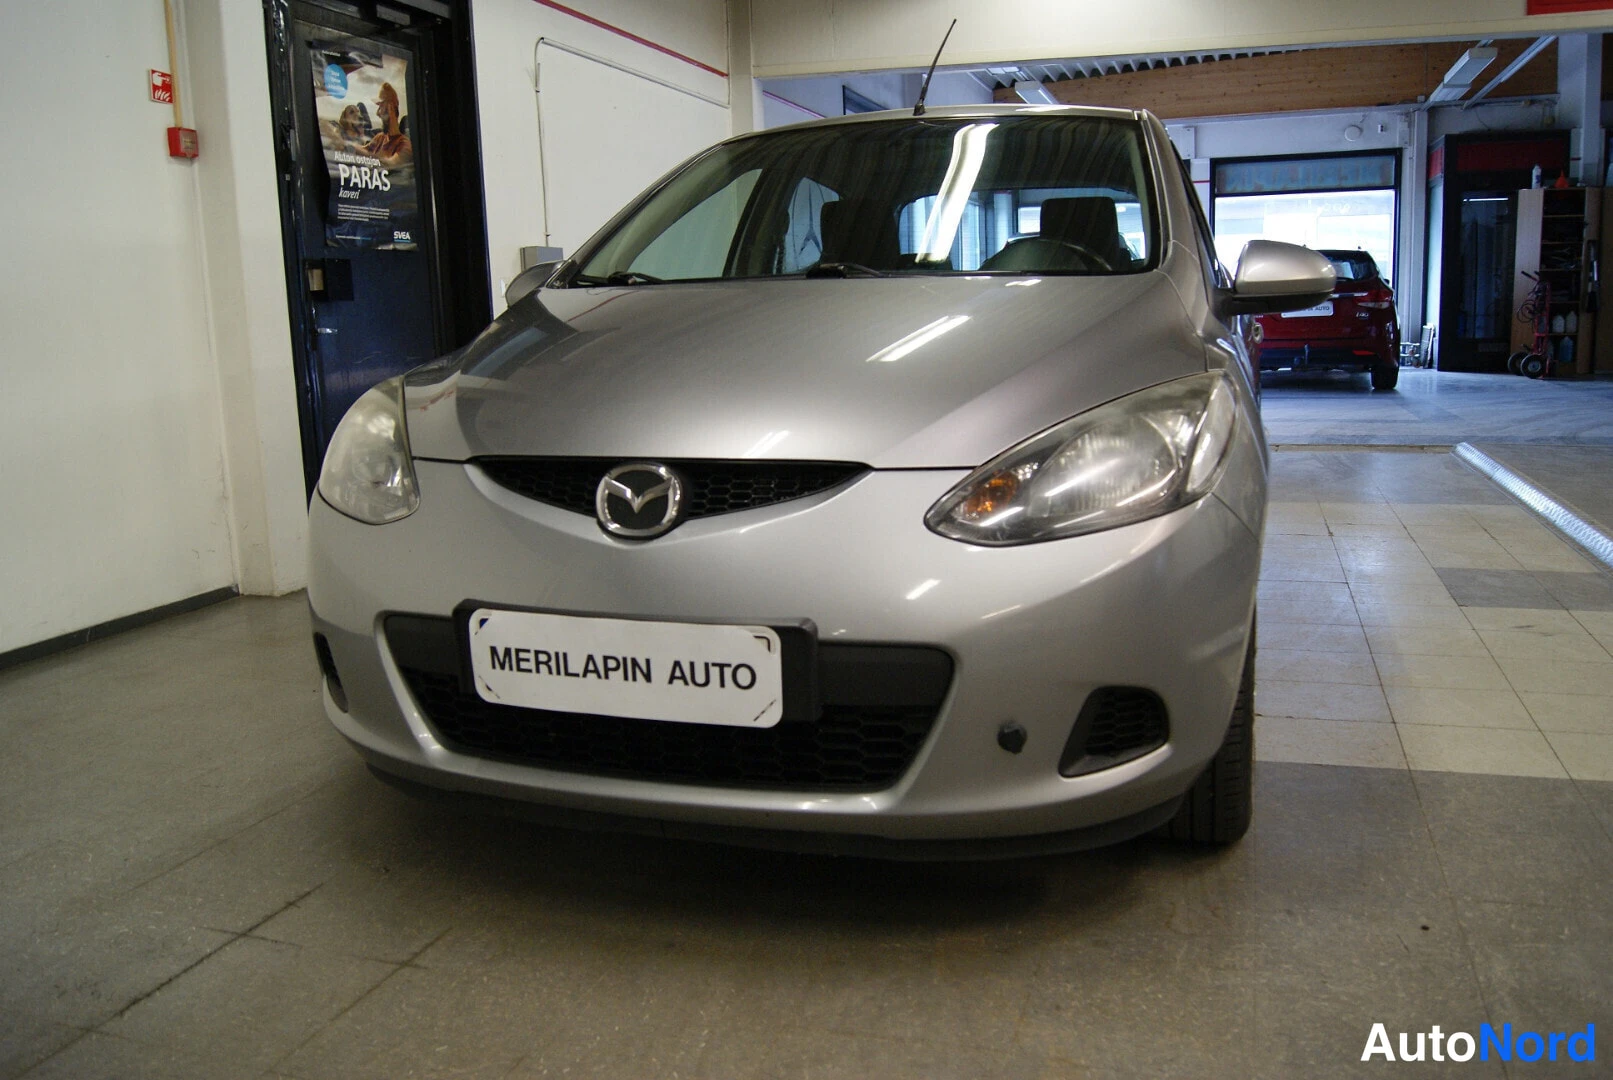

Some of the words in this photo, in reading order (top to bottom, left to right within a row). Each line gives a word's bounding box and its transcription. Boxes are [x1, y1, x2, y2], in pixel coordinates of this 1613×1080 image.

[338, 163, 391, 192] PARAS
[338, 187, 361, 199] kaveri
[393, 230, 411, 240] SVEA
[489, 645, 652, 684] MERILAPIN
[668, 659, 757, 690] AUTO
